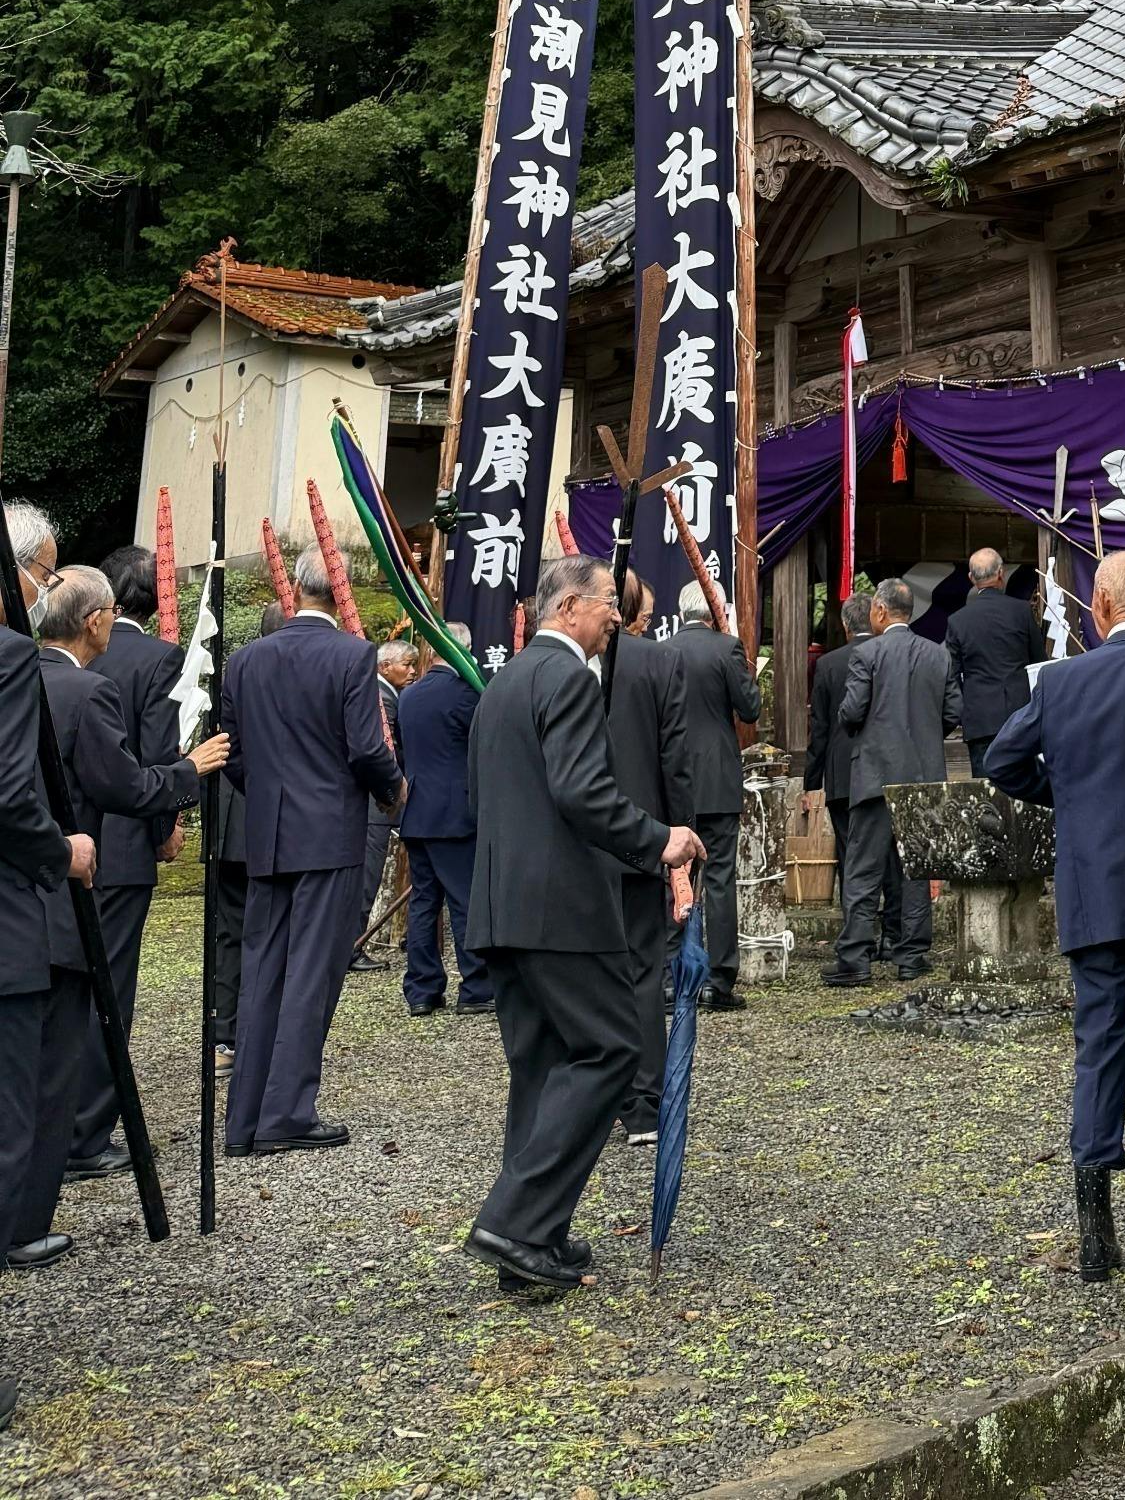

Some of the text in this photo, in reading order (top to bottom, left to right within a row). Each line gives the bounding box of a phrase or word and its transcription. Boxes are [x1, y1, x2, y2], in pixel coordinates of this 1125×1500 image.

[466, 1, 583, 592] 潮見神社大廣前
